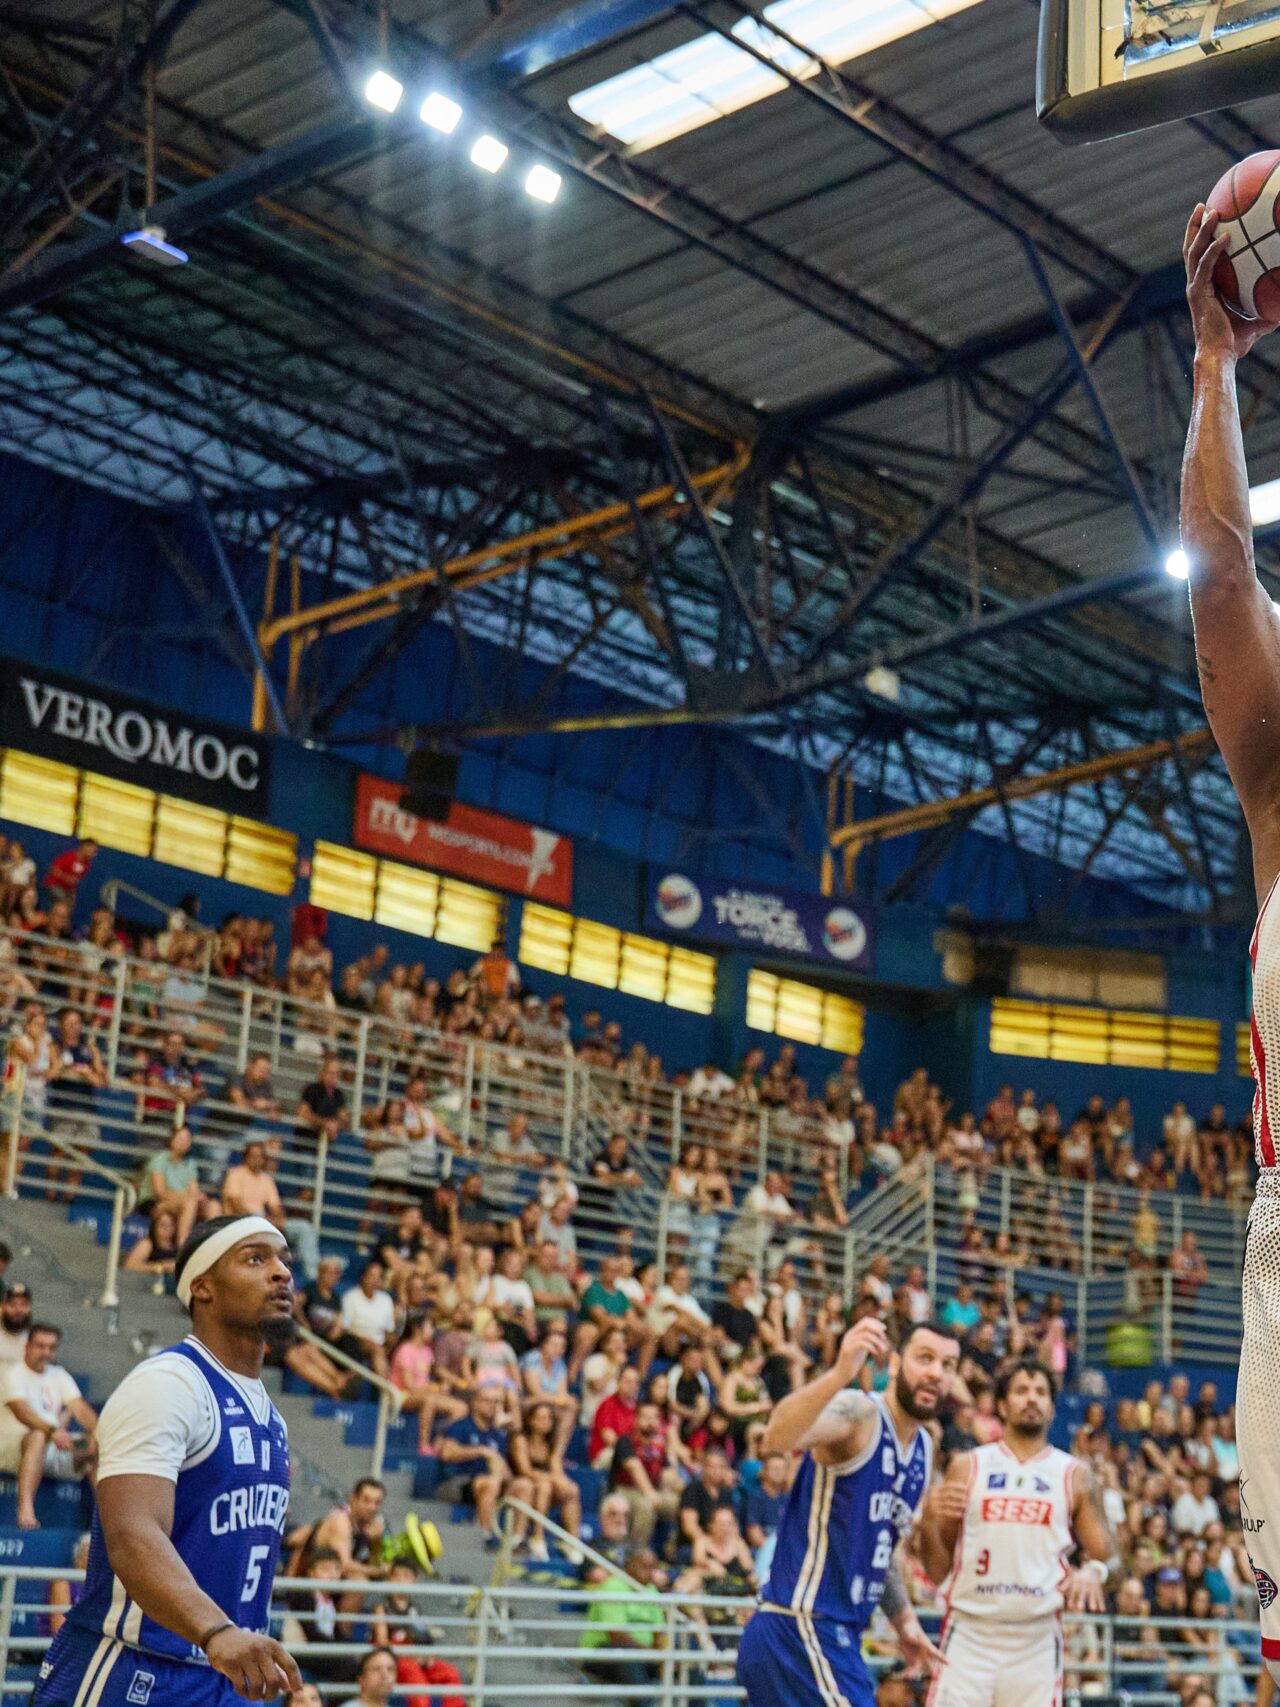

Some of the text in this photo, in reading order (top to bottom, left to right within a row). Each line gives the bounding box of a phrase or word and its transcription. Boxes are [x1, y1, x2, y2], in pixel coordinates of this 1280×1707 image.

[20, 677, 260, 791] VEROMOC
[987, 1500, 1049, 1523] SESI
[241, 1545, 270, 1602] 5
